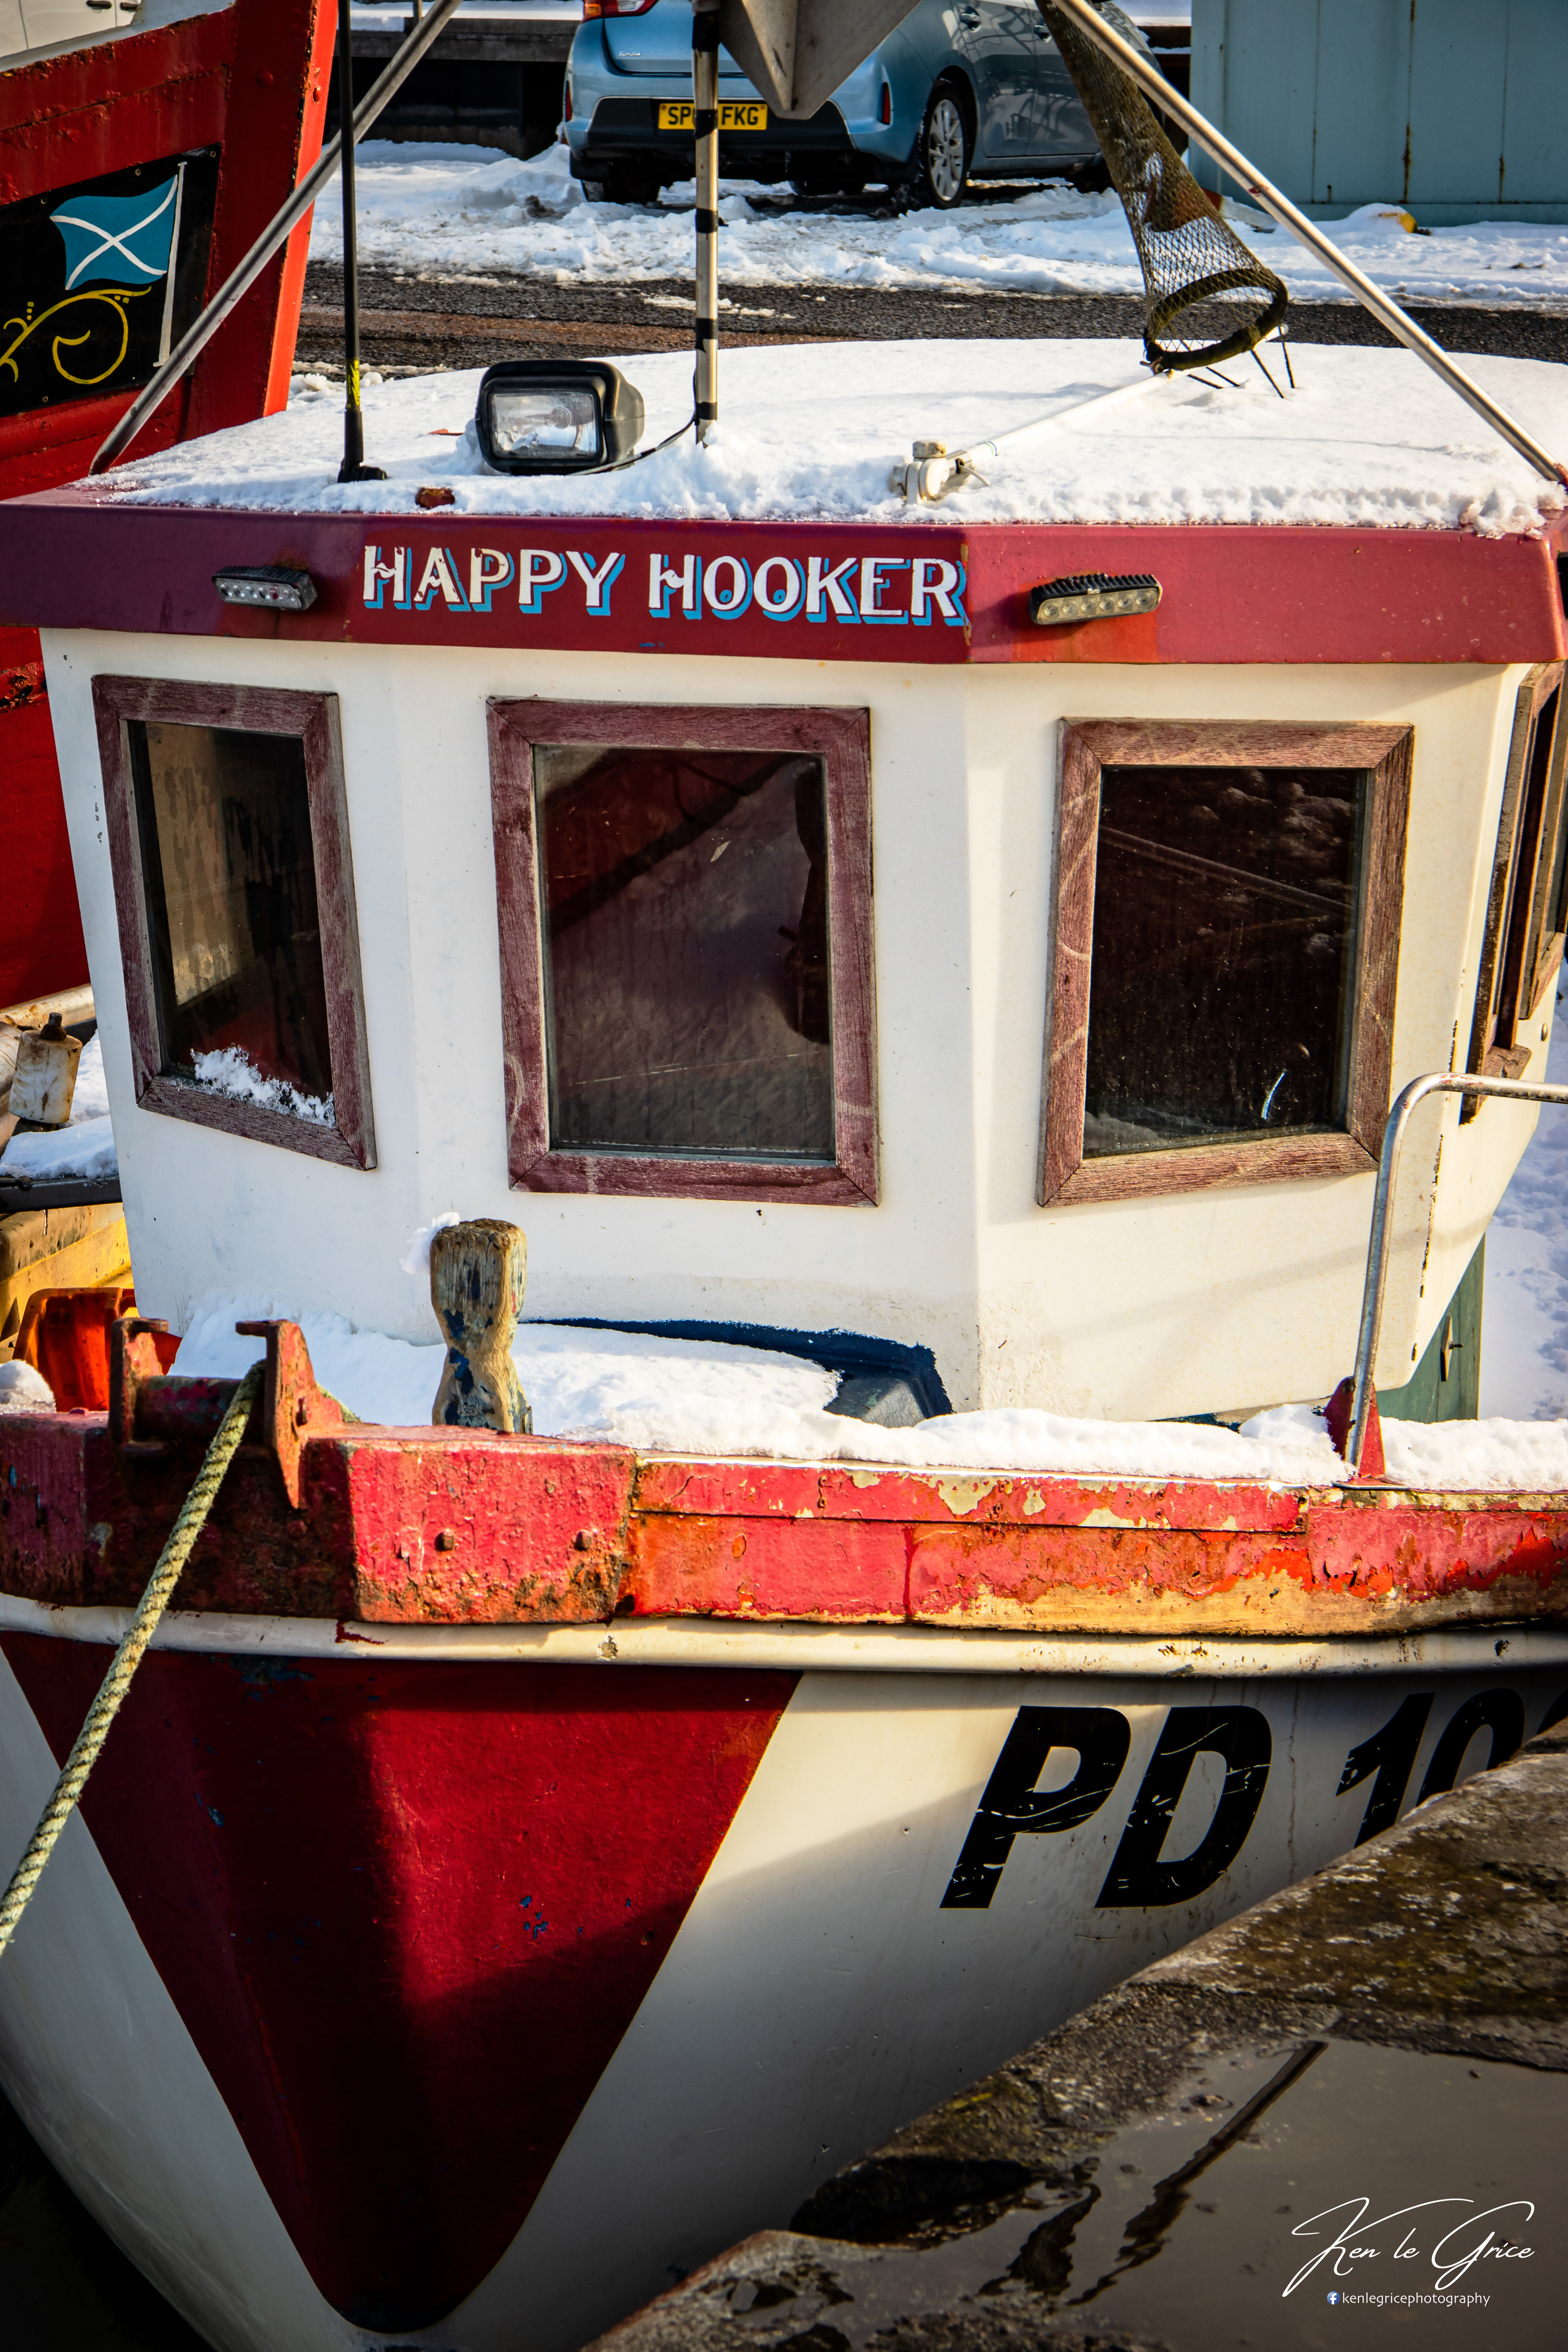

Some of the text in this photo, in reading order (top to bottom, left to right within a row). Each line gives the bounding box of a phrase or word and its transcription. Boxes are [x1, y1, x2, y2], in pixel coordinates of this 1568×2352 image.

[668, 107, 758, 125] SP FKG
[363, 545, 967, 627] HAPPY HOOKER
[939, 1687, 1568, 1909] PD 10
